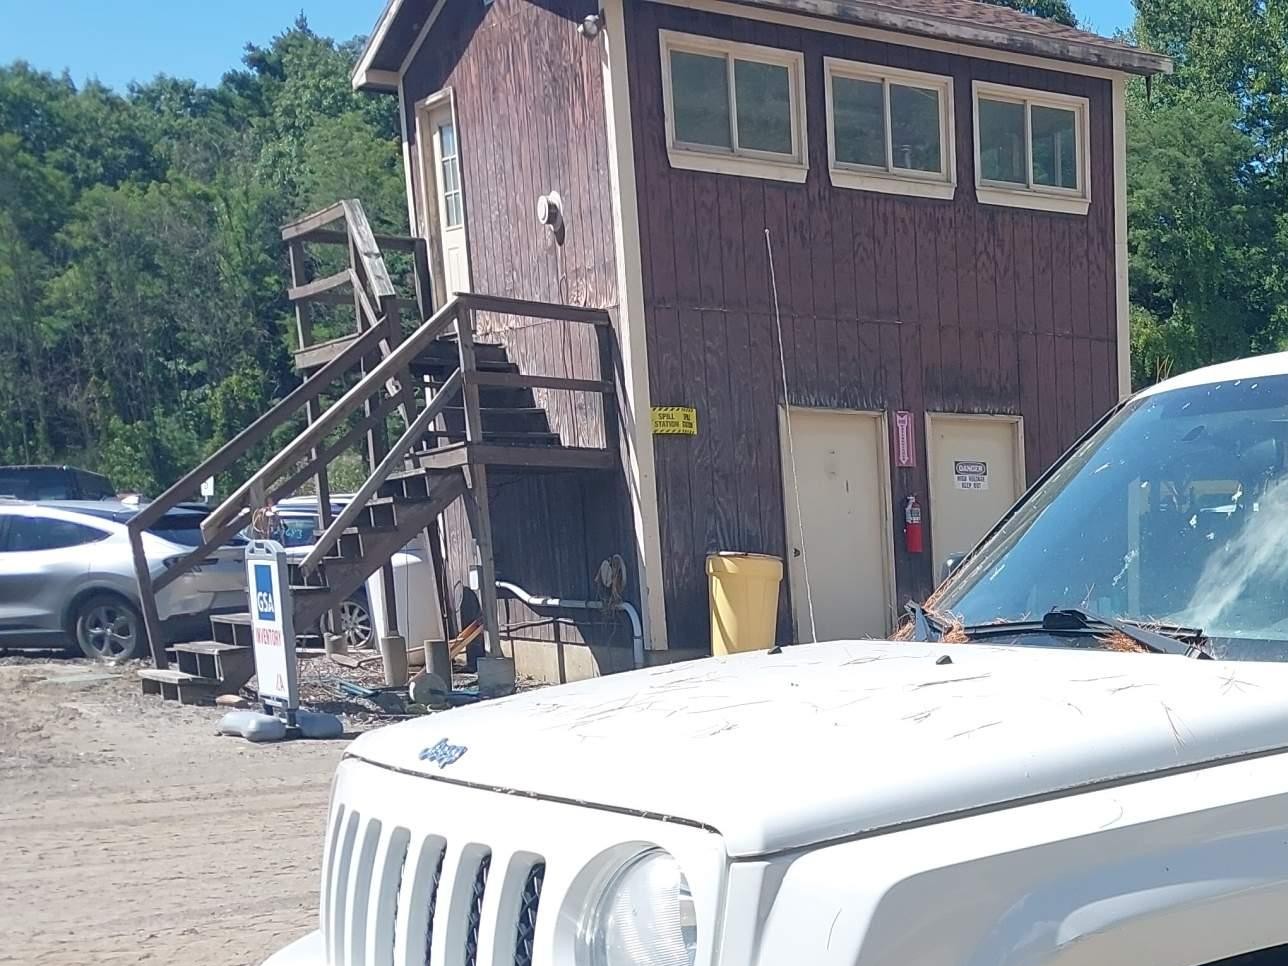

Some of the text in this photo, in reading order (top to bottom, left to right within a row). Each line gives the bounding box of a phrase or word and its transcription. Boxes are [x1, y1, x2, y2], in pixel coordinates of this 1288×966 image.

[958, 464, 983, 472] DANGER
[257, 591, 276, 613] GSA
[255, 626, 282, 646] INVENTORY
[419, 737, 468, 769] Jeep
